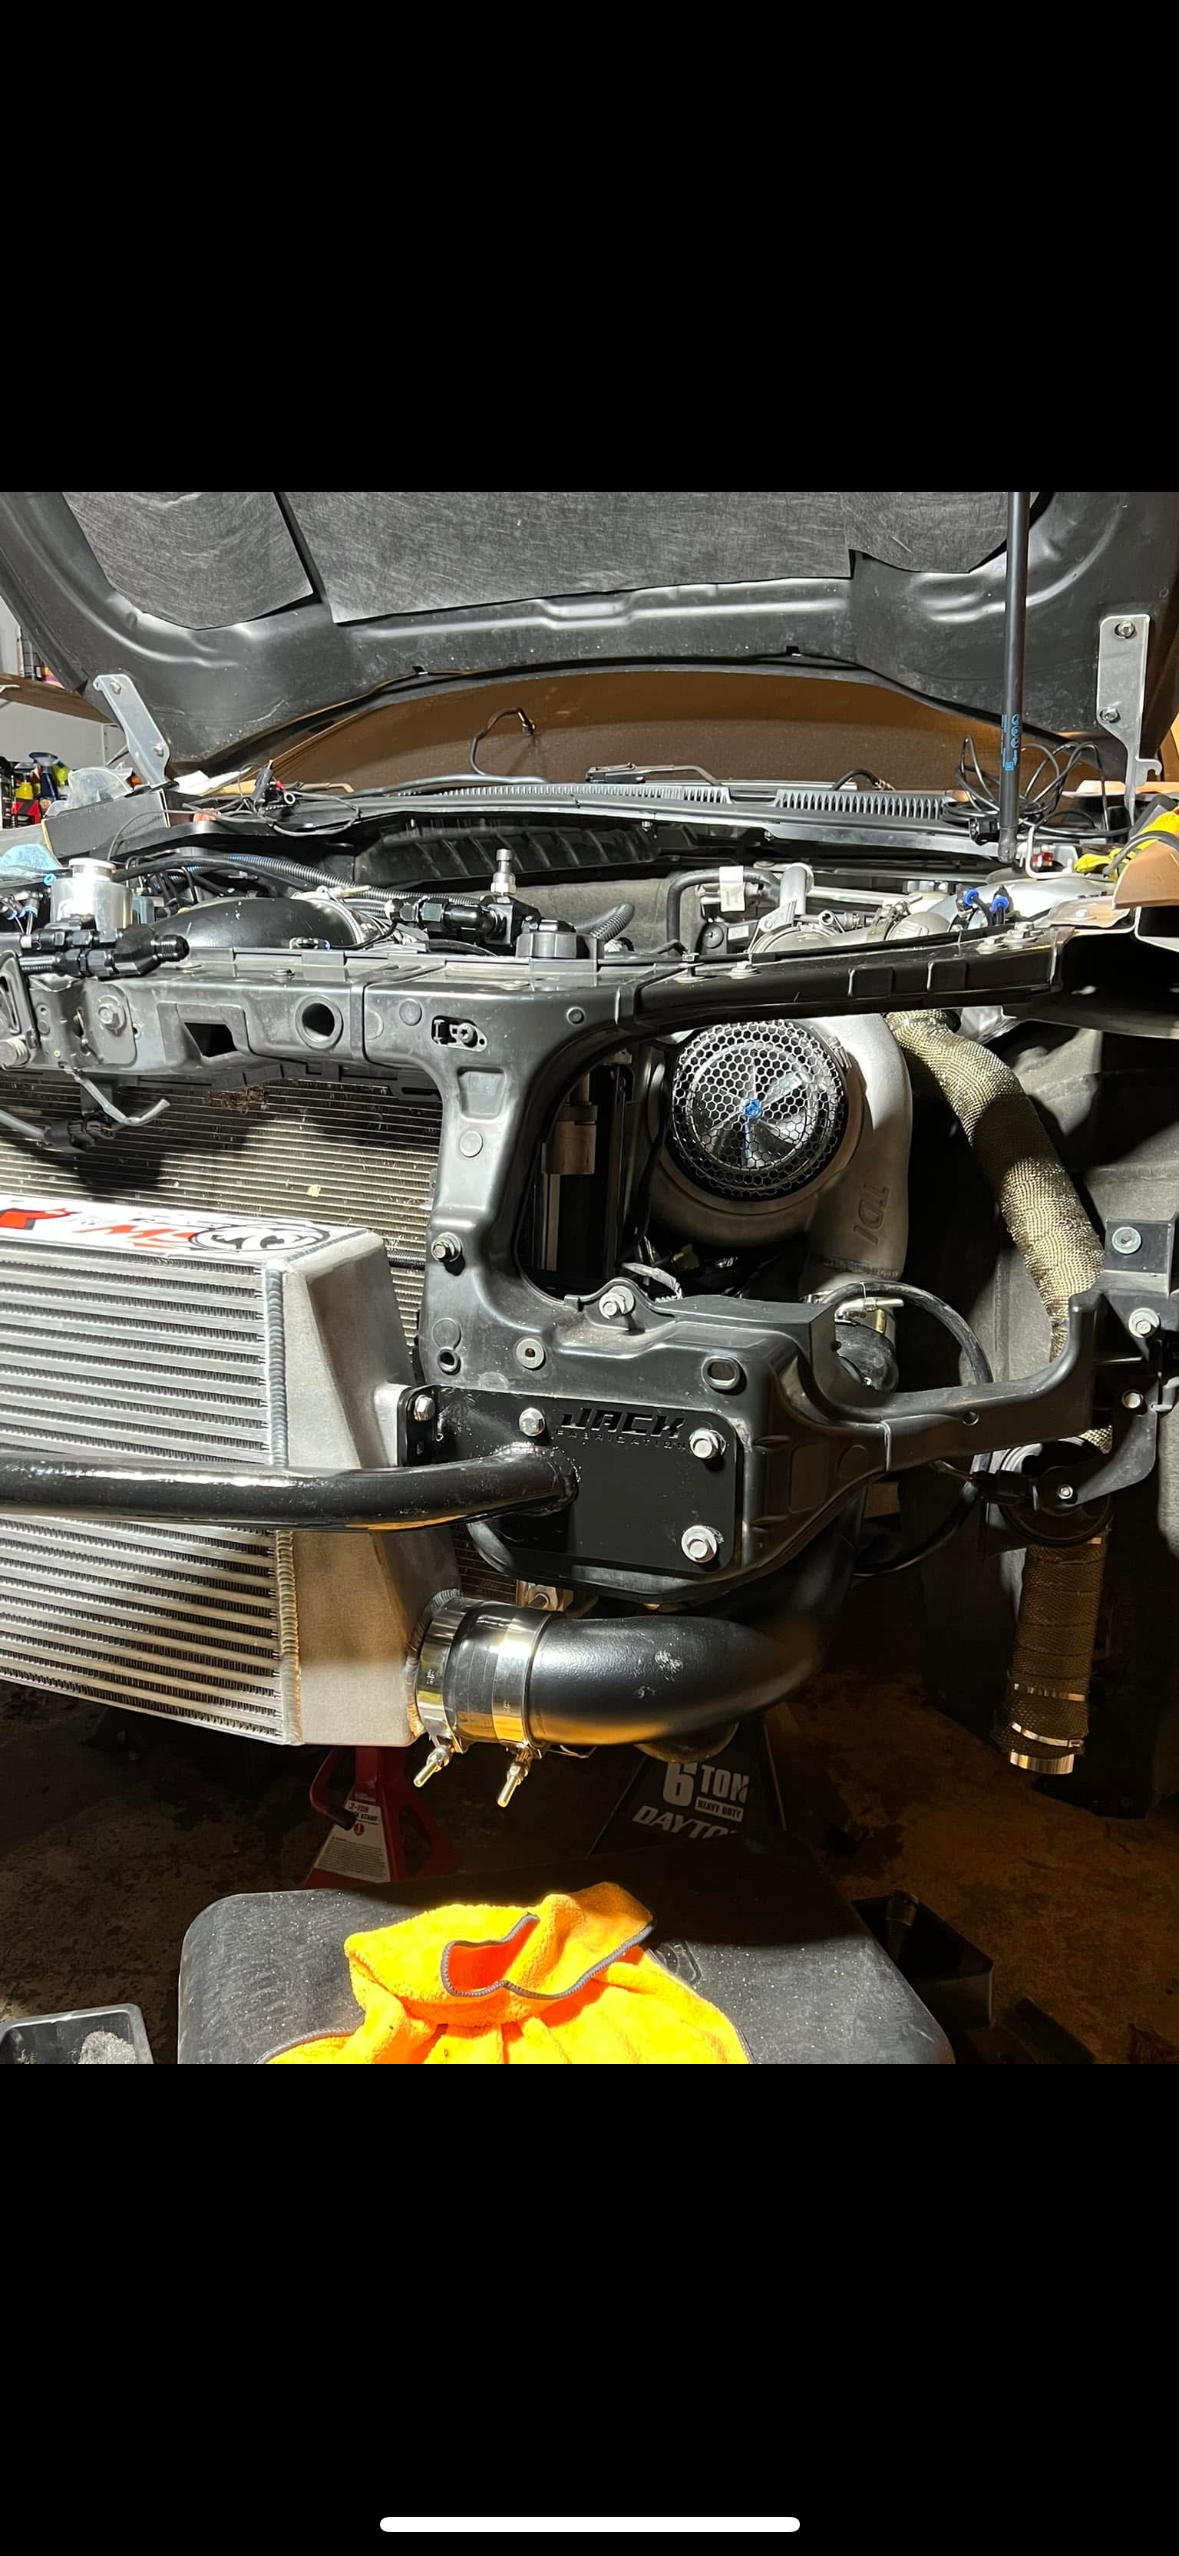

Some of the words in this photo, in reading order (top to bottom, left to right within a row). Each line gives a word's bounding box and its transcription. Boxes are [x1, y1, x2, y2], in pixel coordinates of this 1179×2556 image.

[560, 1408, 685, 1439] JACK
[662, 1761, 698, 1807] 6
[700, 1764, 750, 1803] TON
[632, 1805, 738, 1839] DAYTO
[697, 1799, 720, 1814] HEAVY
[722, 1806, 742, 1819] DUTY
